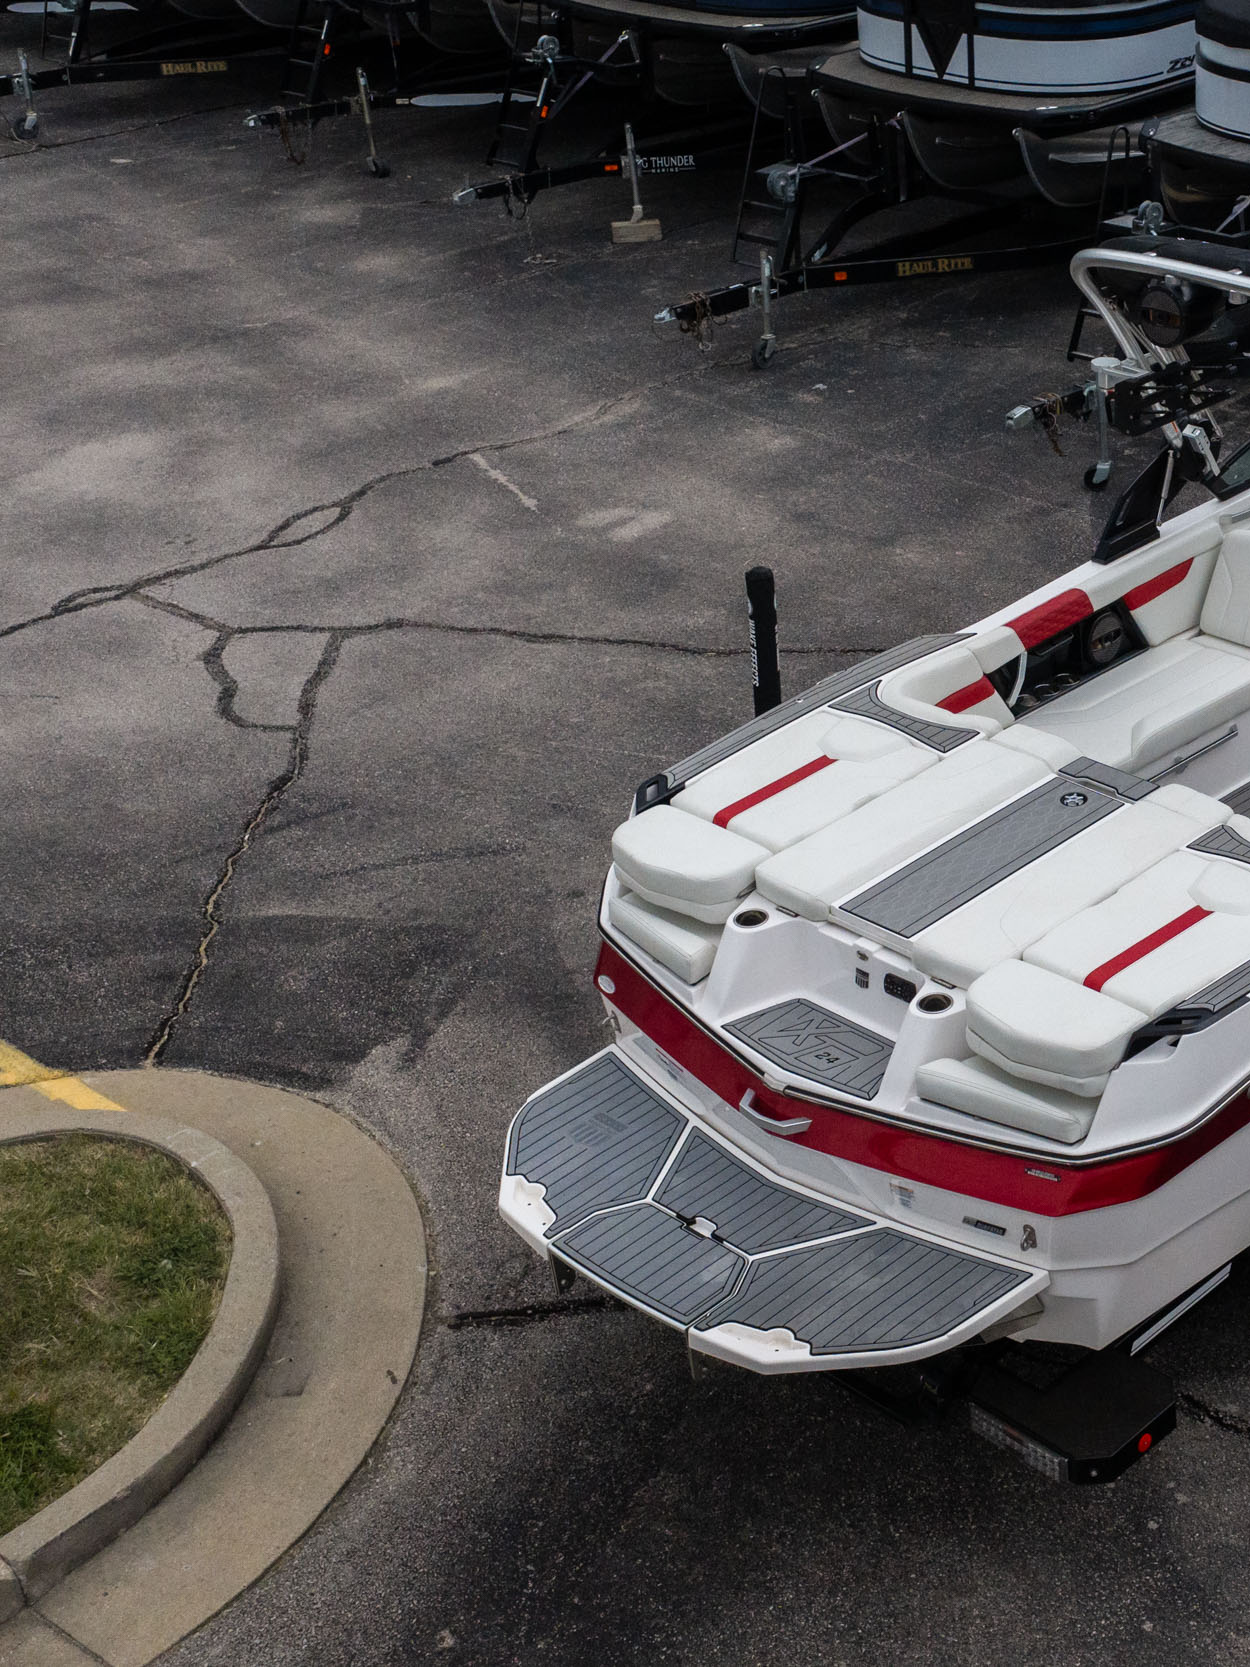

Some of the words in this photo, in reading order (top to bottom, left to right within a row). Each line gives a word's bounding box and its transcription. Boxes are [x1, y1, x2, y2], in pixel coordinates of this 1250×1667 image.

[161, 62, 196, 75] HAUL
[197, 61, 227, 73] RITE
[650, 154, 695, 168] THUNDER
[897, 260, 936, 277] HAUL
[938, 256, 974, 273] RITE
[814, 1051, 840, 1064] 24
